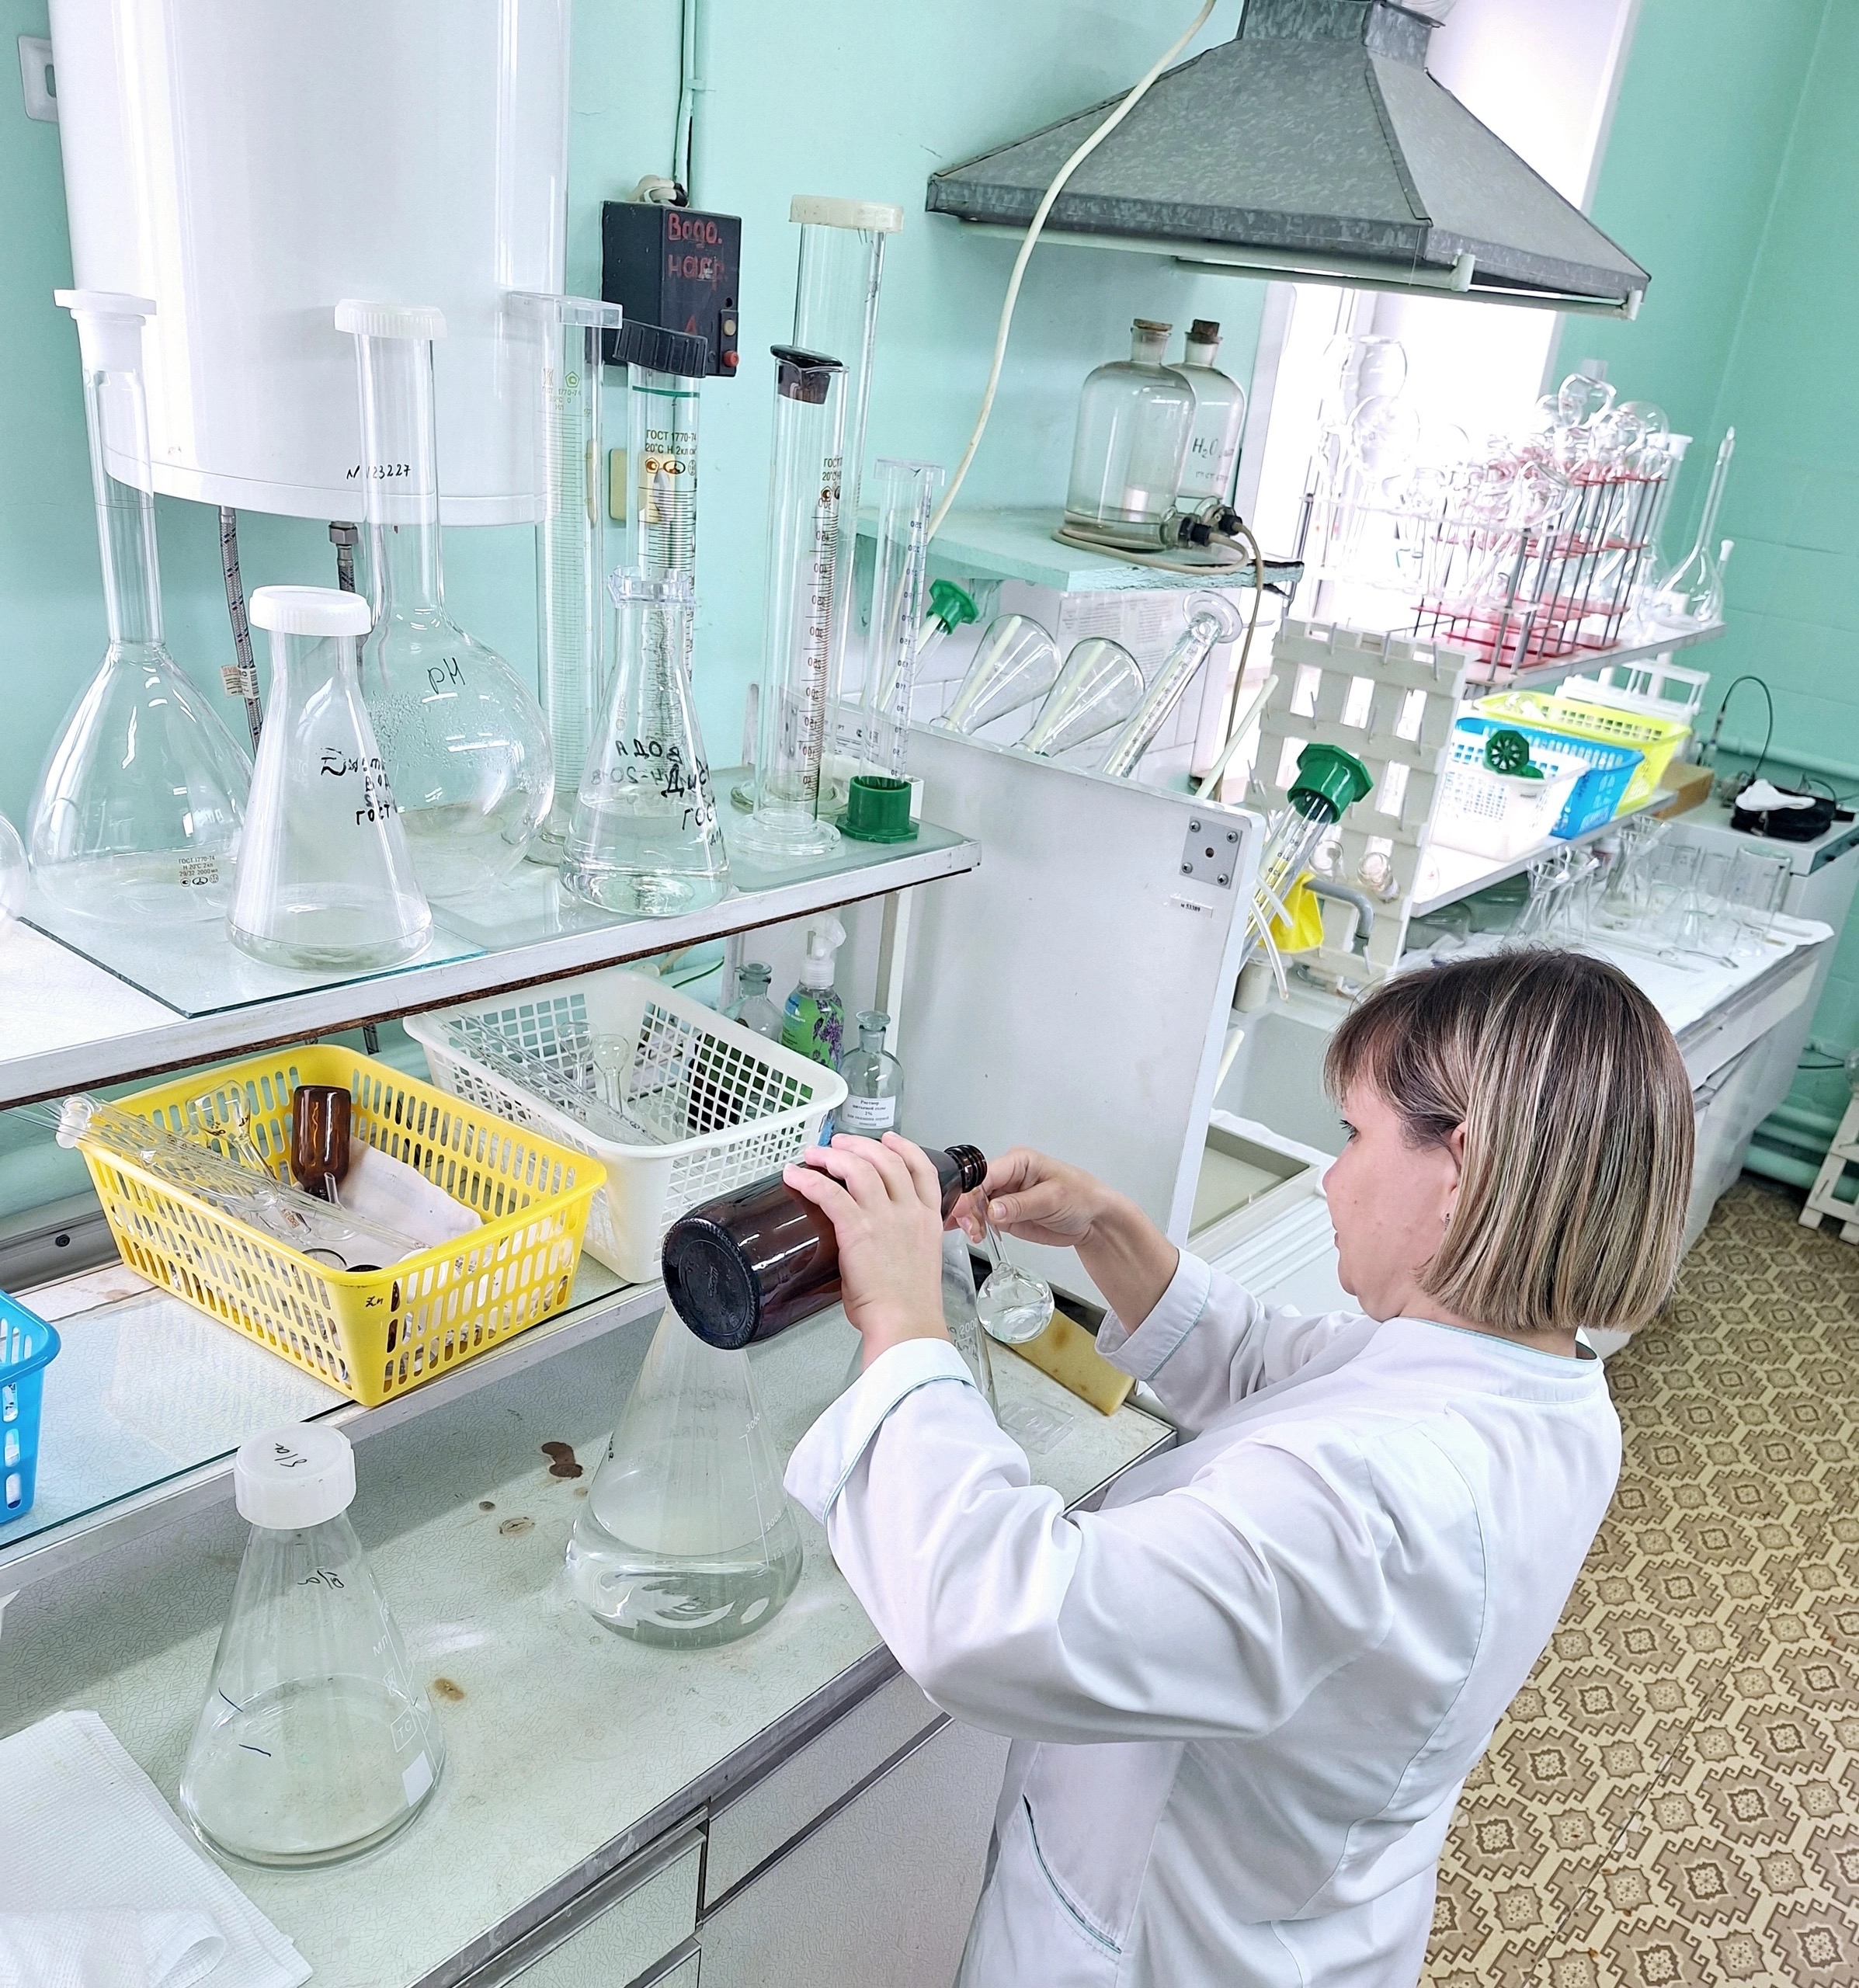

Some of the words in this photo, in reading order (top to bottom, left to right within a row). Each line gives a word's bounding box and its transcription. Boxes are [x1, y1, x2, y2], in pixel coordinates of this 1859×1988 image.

[646, 429, 669, 441] ГОСТ
[745, 1412, 761, 1433] 3000
[766, 1510, 783, 1531] 2000
